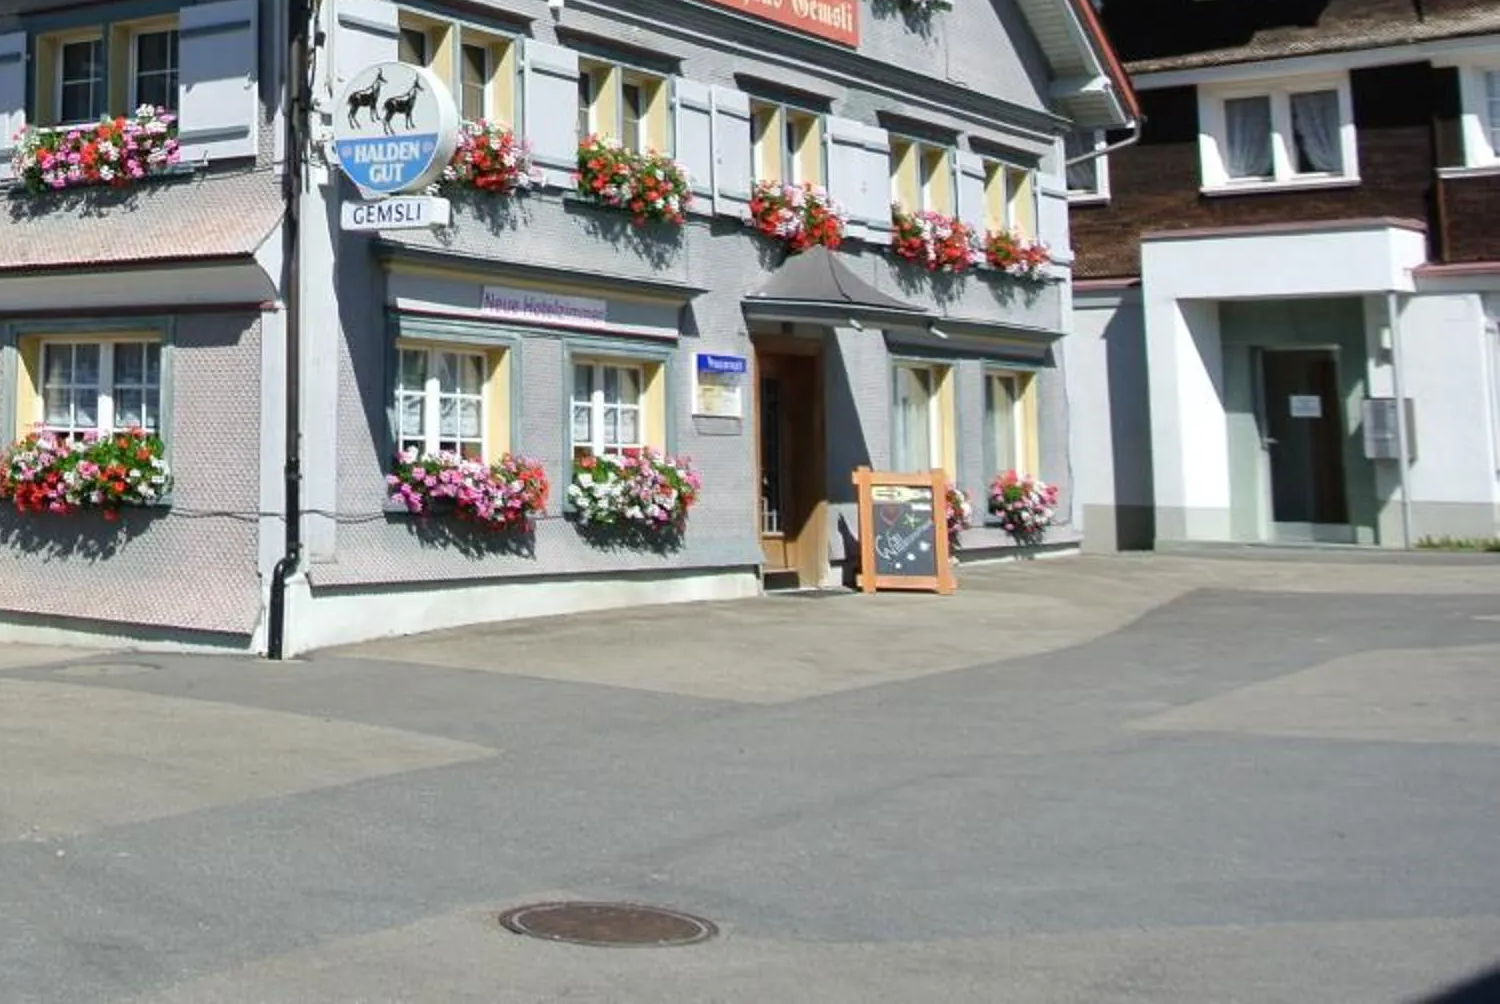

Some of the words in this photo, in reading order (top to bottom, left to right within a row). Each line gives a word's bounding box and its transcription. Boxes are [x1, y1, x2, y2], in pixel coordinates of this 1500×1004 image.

[354, 141, 421, 163] HALDEN
[368, 163, 405, 183] GUT
[352, 203, 422, 225] GEMSLI
